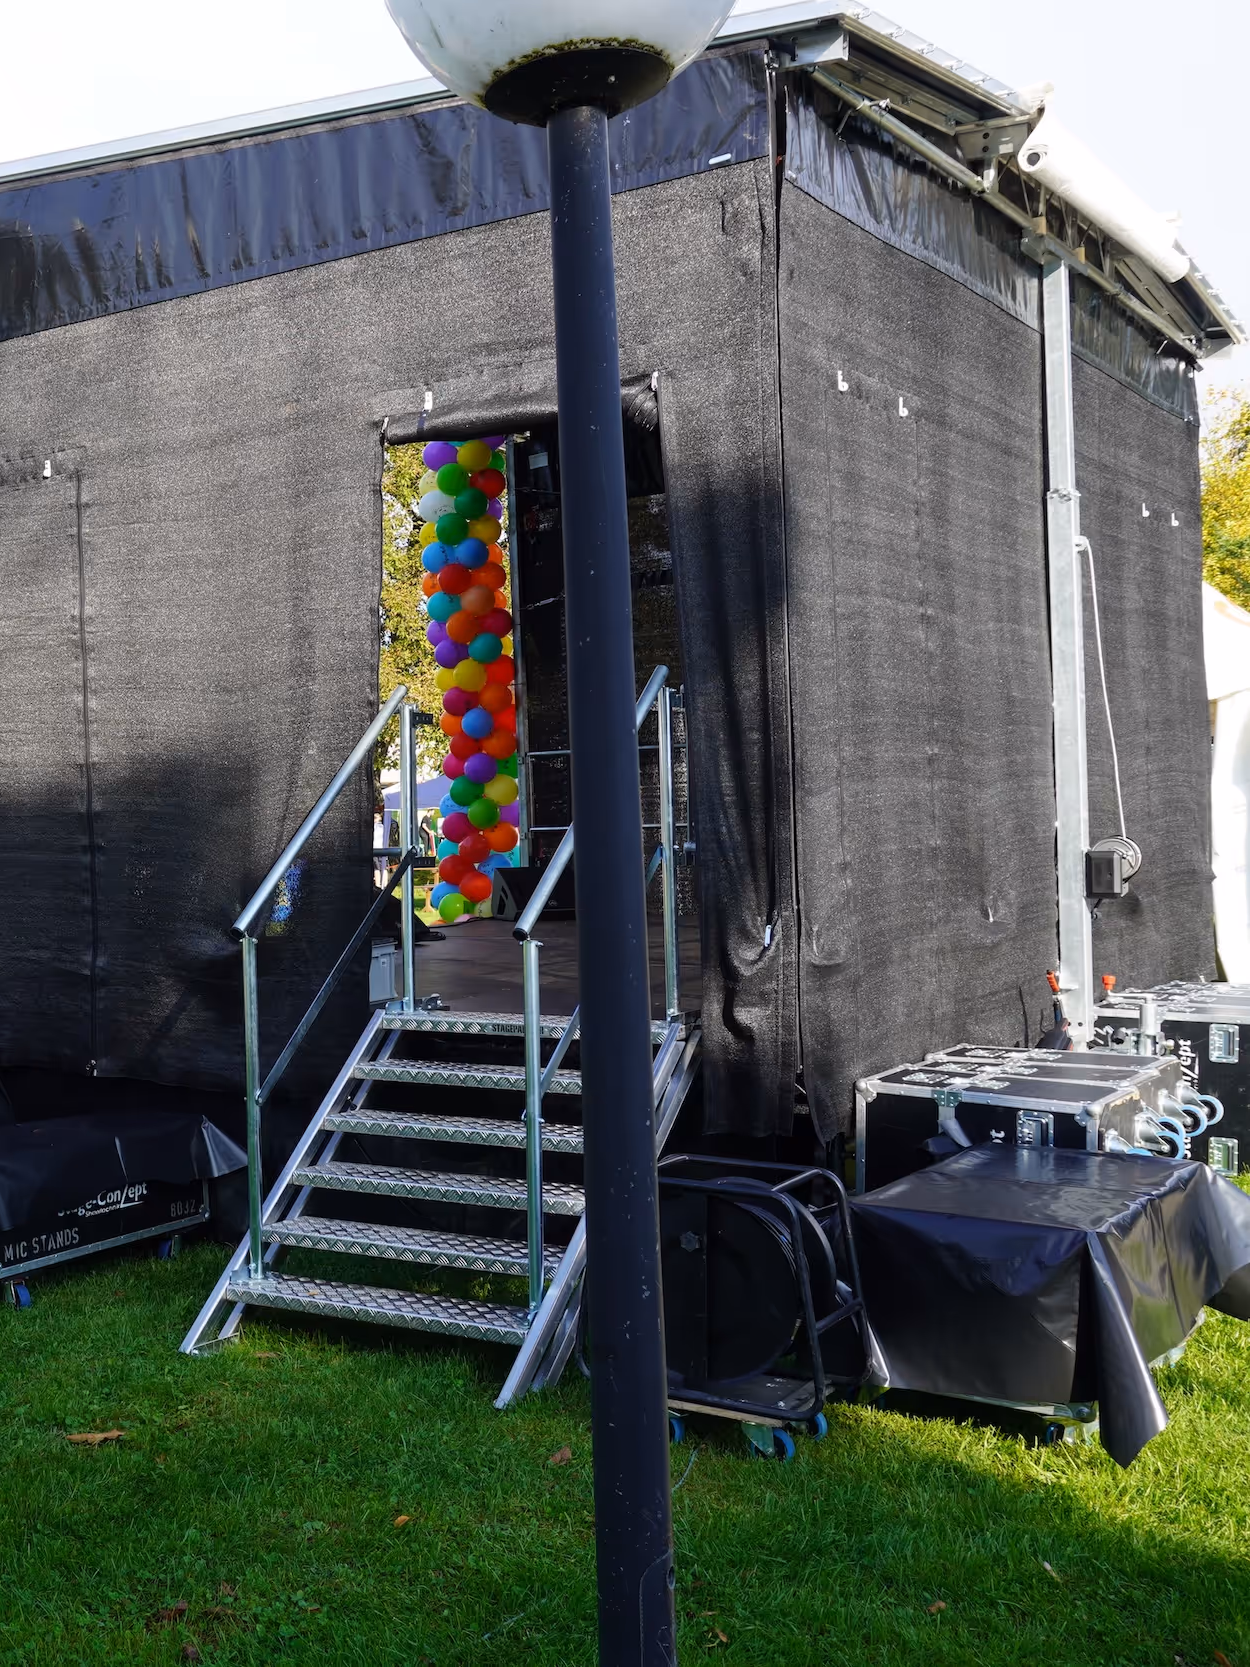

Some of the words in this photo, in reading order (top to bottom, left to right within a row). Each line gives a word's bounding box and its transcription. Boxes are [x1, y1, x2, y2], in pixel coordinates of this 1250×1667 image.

[492, 1023, 544, 1035] STAGEPAR
[4, 1241, 28, 1263] MIC
[31, 1227, 80, 1254] STANDS
